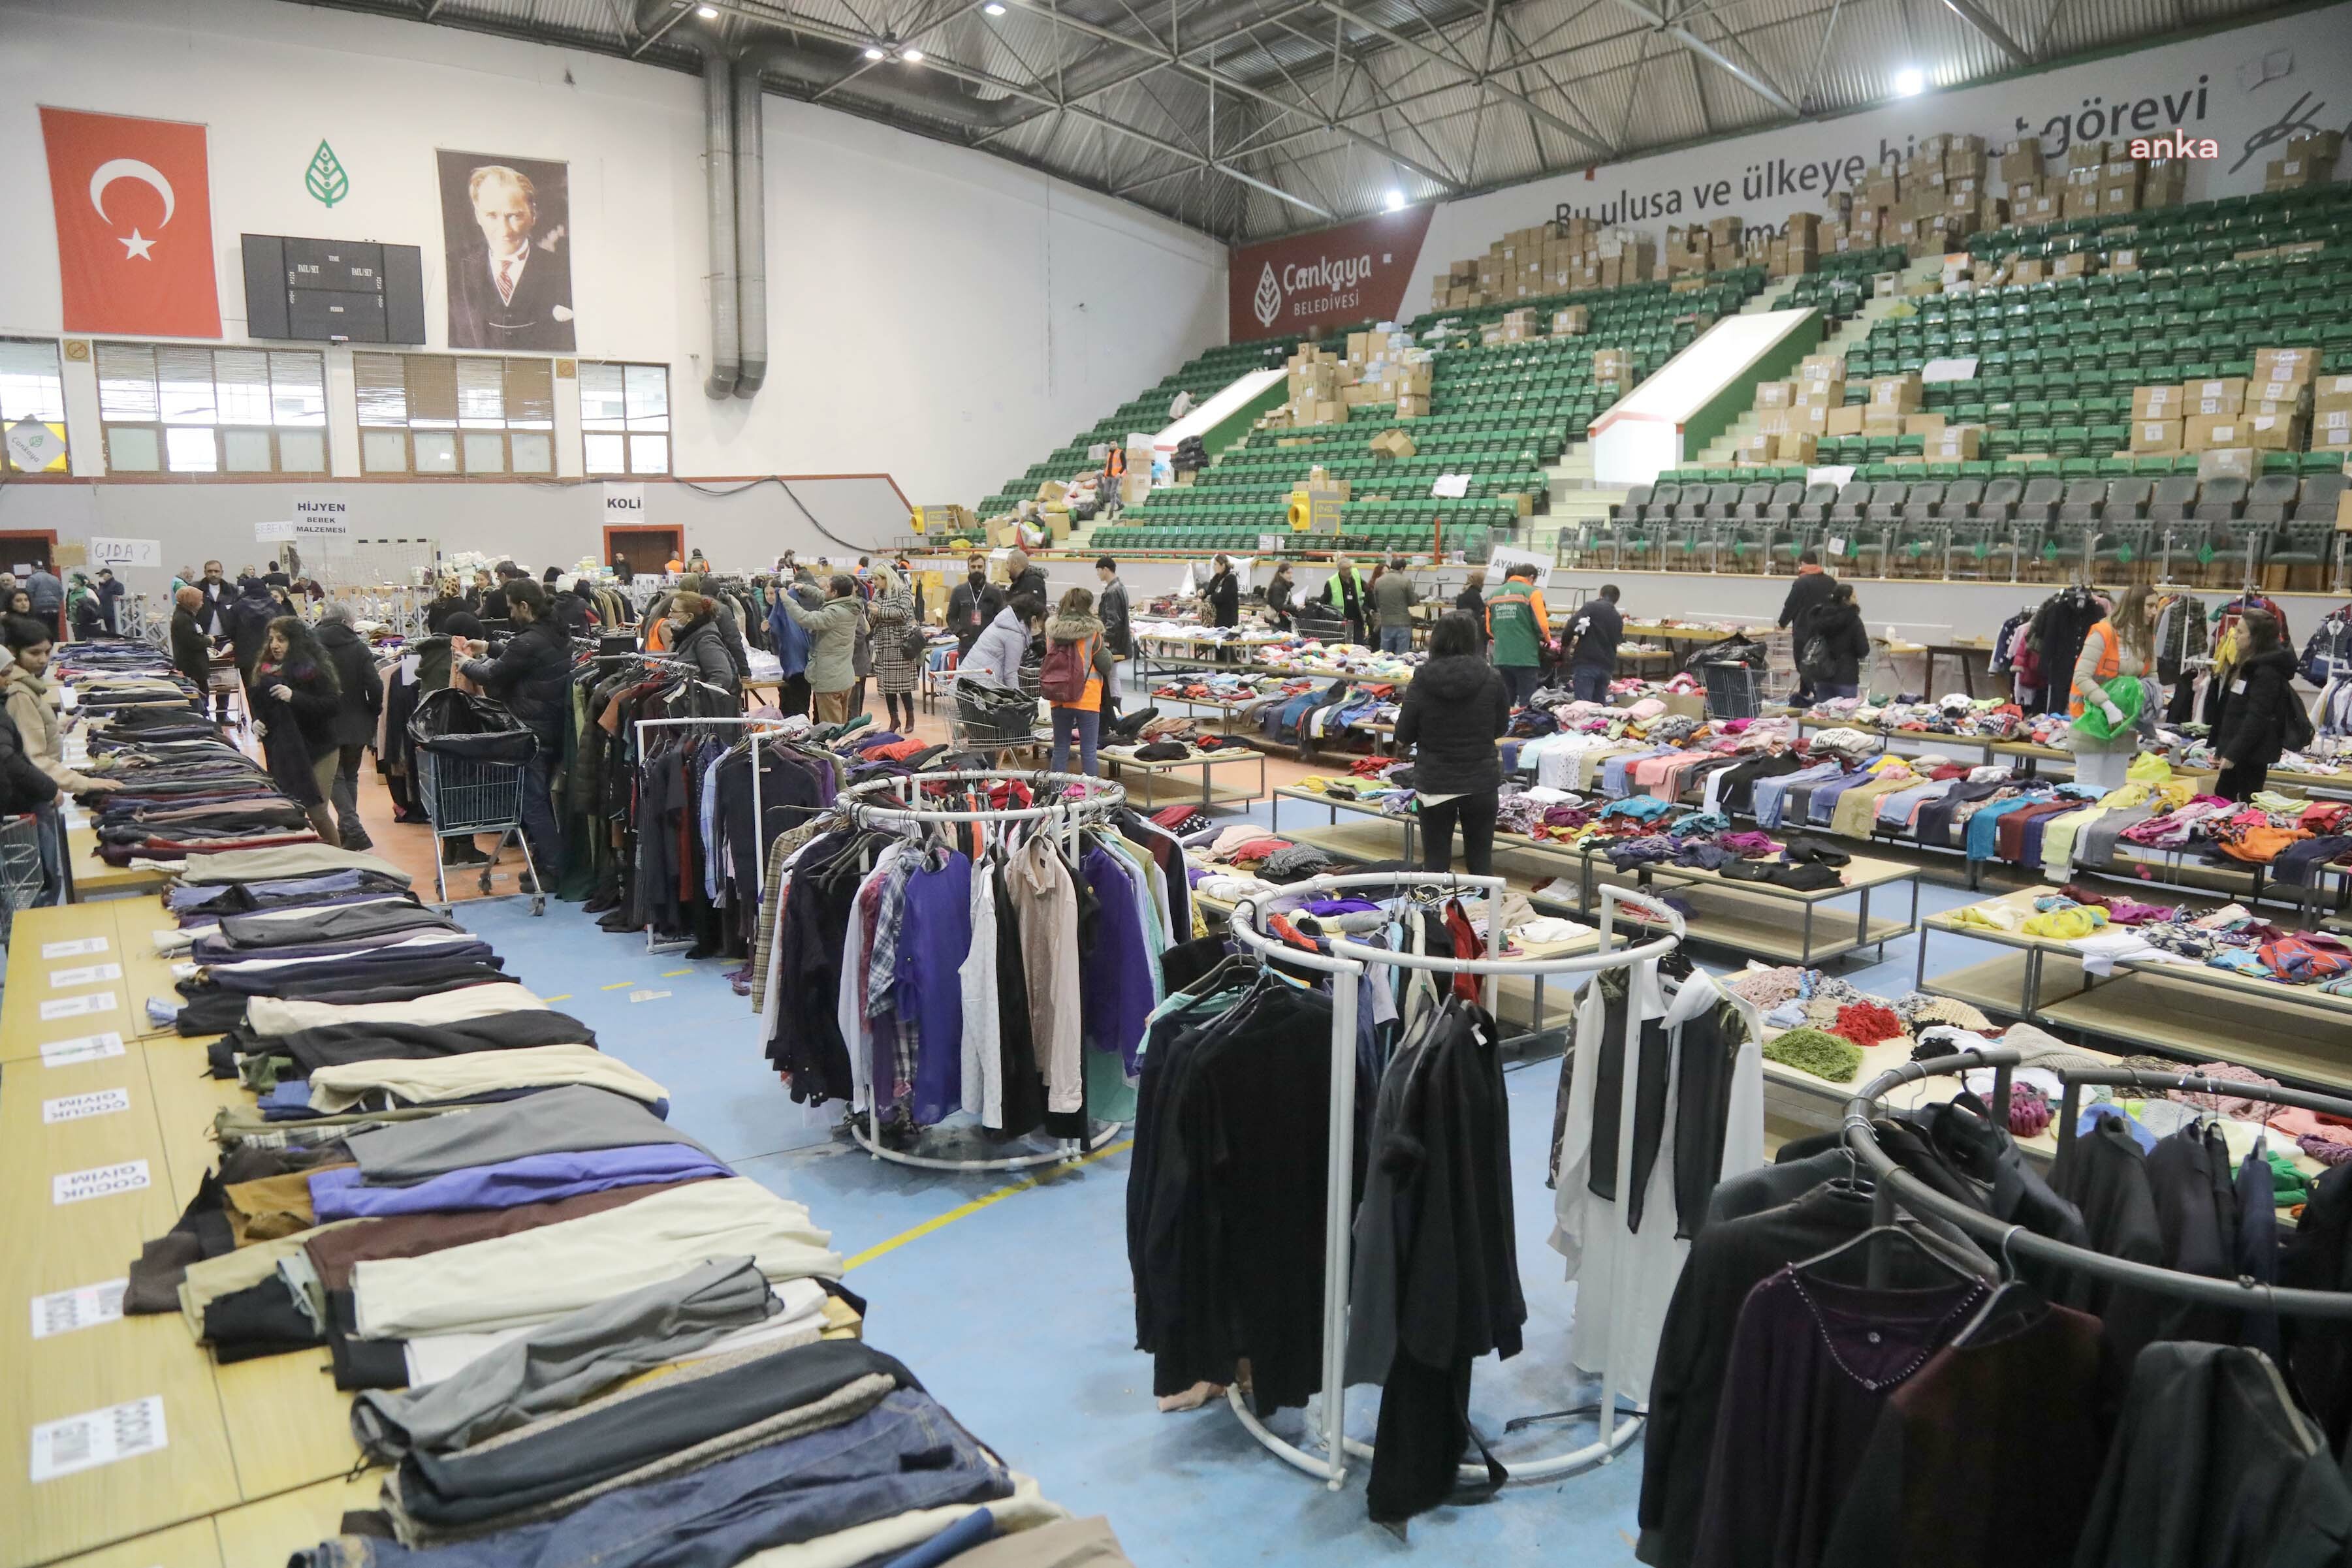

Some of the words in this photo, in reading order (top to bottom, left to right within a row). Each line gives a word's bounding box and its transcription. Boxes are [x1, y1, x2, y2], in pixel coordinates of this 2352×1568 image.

[2039, 74, 2210, 160] görevi
[1602, 189, 1682, 227] ulusa
[1694, 179, 1732, 210] ve
[1743, 154, 1866, 201] ülkeye
[1283, 255, 1372, 295] Çankaya
[1294, 289, 1359, 316] BELEDİYESİ
[297, 501, 345, 512] HİJYEN
[607, 497, 641, 509] KOLİ
[95, 542, 134, 559] GIDA
